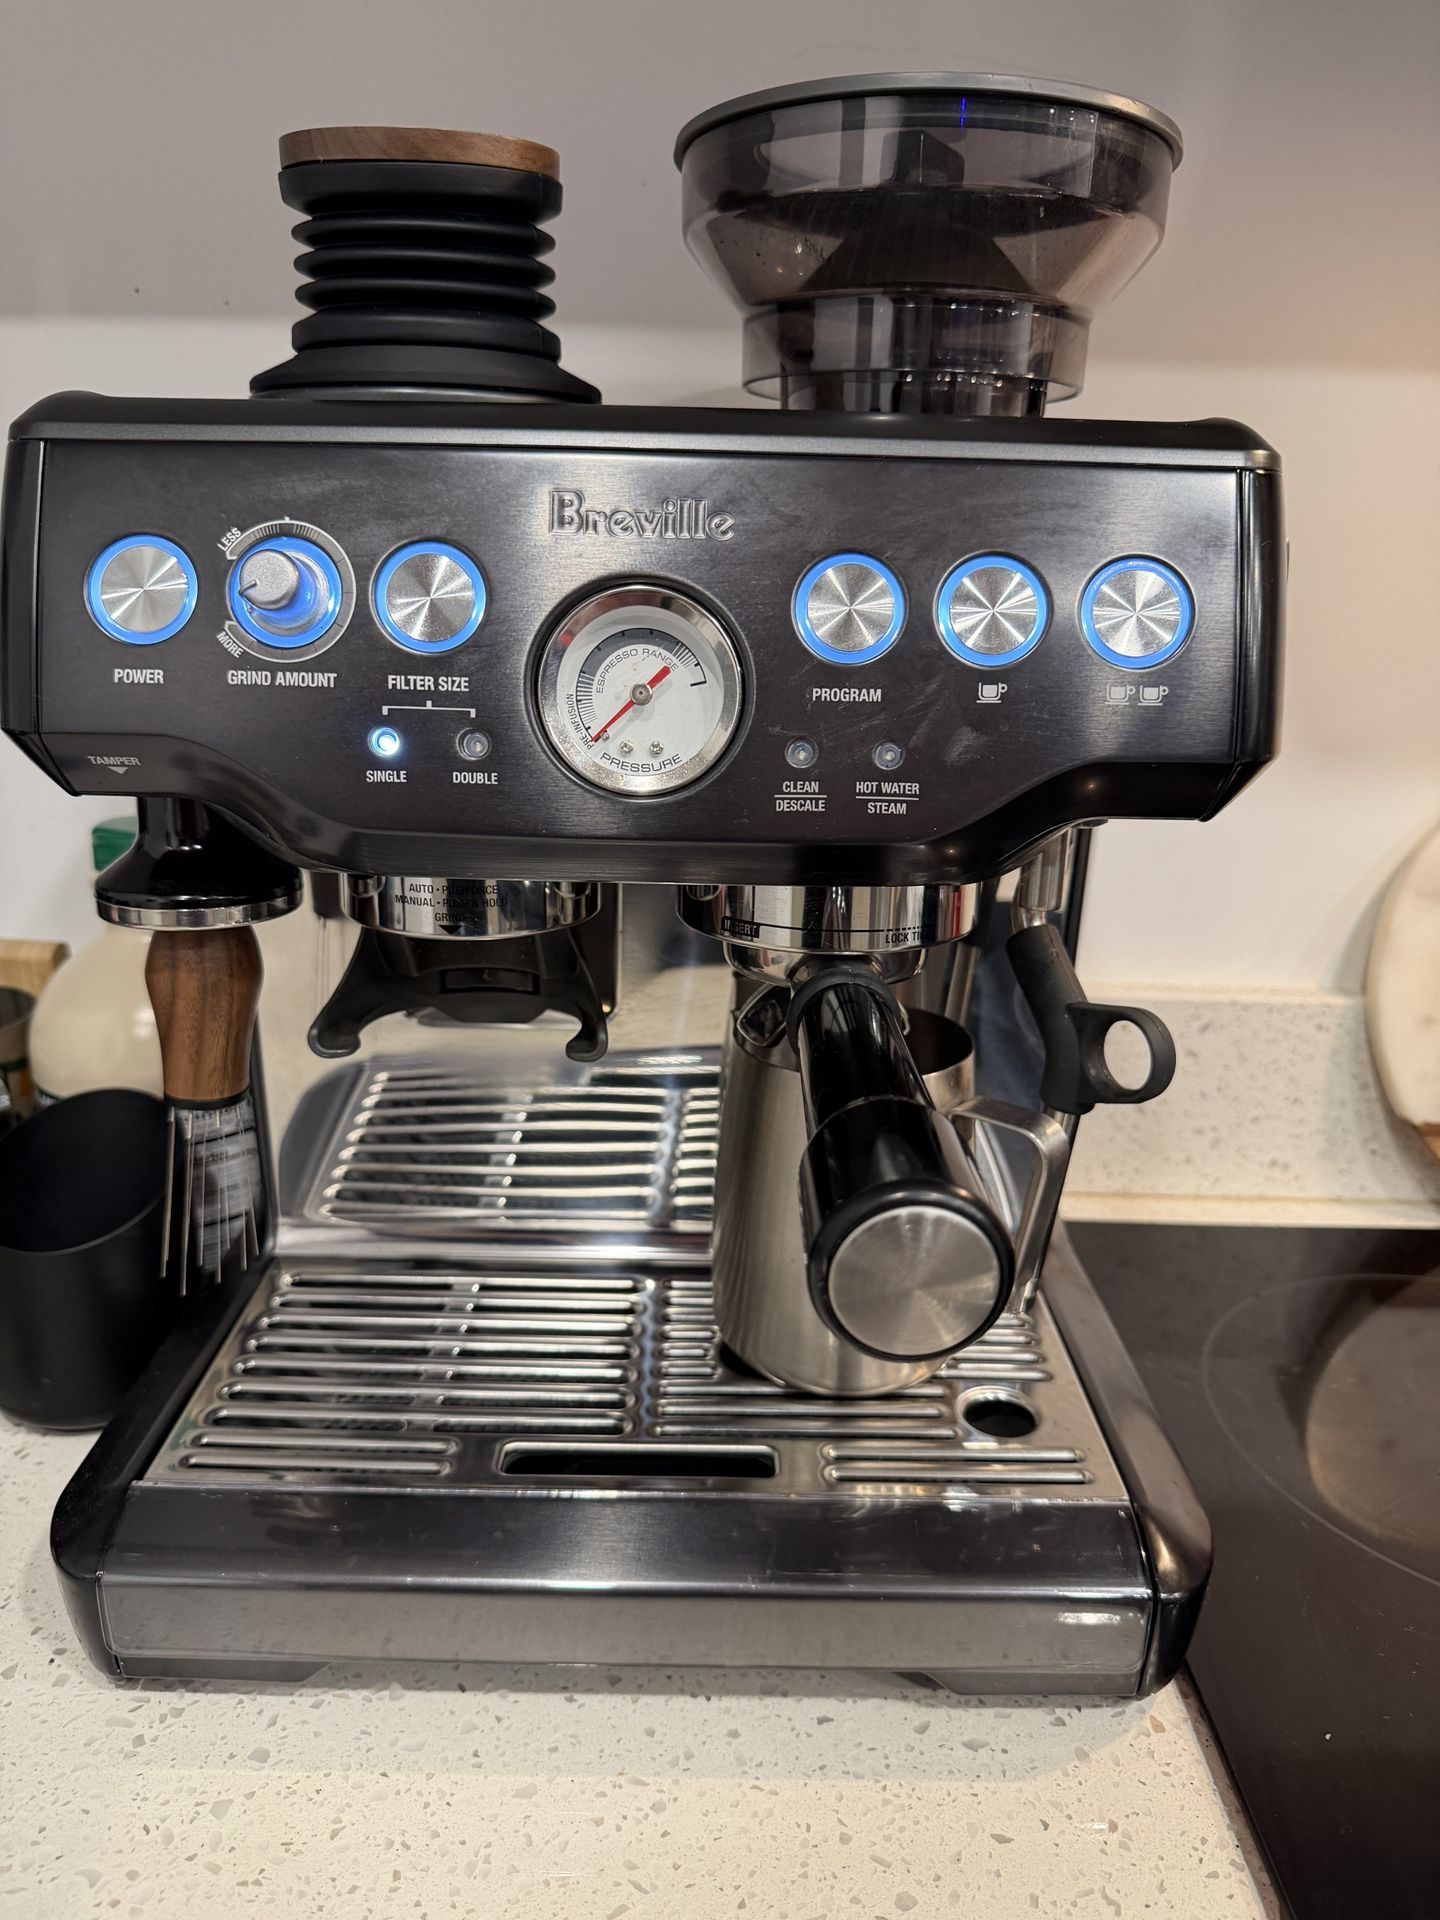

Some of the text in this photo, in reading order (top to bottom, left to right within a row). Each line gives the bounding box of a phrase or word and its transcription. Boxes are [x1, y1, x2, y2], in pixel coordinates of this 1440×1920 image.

[549, 488, 735, 541] Breville
[217, 526, 242, 551] LESS
[216, 631, 244, 659] MORE
[114, 668, 164, 684] POWER
[596, 648, 679, 693] ESPRESSO RANGE
[227, 670, 337, 688] GRIND AMOUNT
[388, 675, 469, 692] FILTER SIZE
[812, 687, 882, 703] PROGRAM
[566, 693, 595, 750] PRE-INFUSION
[87, 755, 142, 766] TAMPER
[600, 752, 683, 773] PRESSURE
[366, 770, 407, 783] SINGLE
[453, 771, 498, 785] DOUBLE
[782, 781, 819, 794] CLEAN
[855, 781, 920, 796] HOT WATER
[775, 799, 826, 813] DESCALE
[867, 801, 907, 815] STEAM
[409, 883, 434, 894] AUTO
[395, 894, 435, 907] MANUAL
[482, 897, 508, 908] HOLD
[435, 912, 466, 922] GRIND
[885, 932, 910, 944] LOCK
